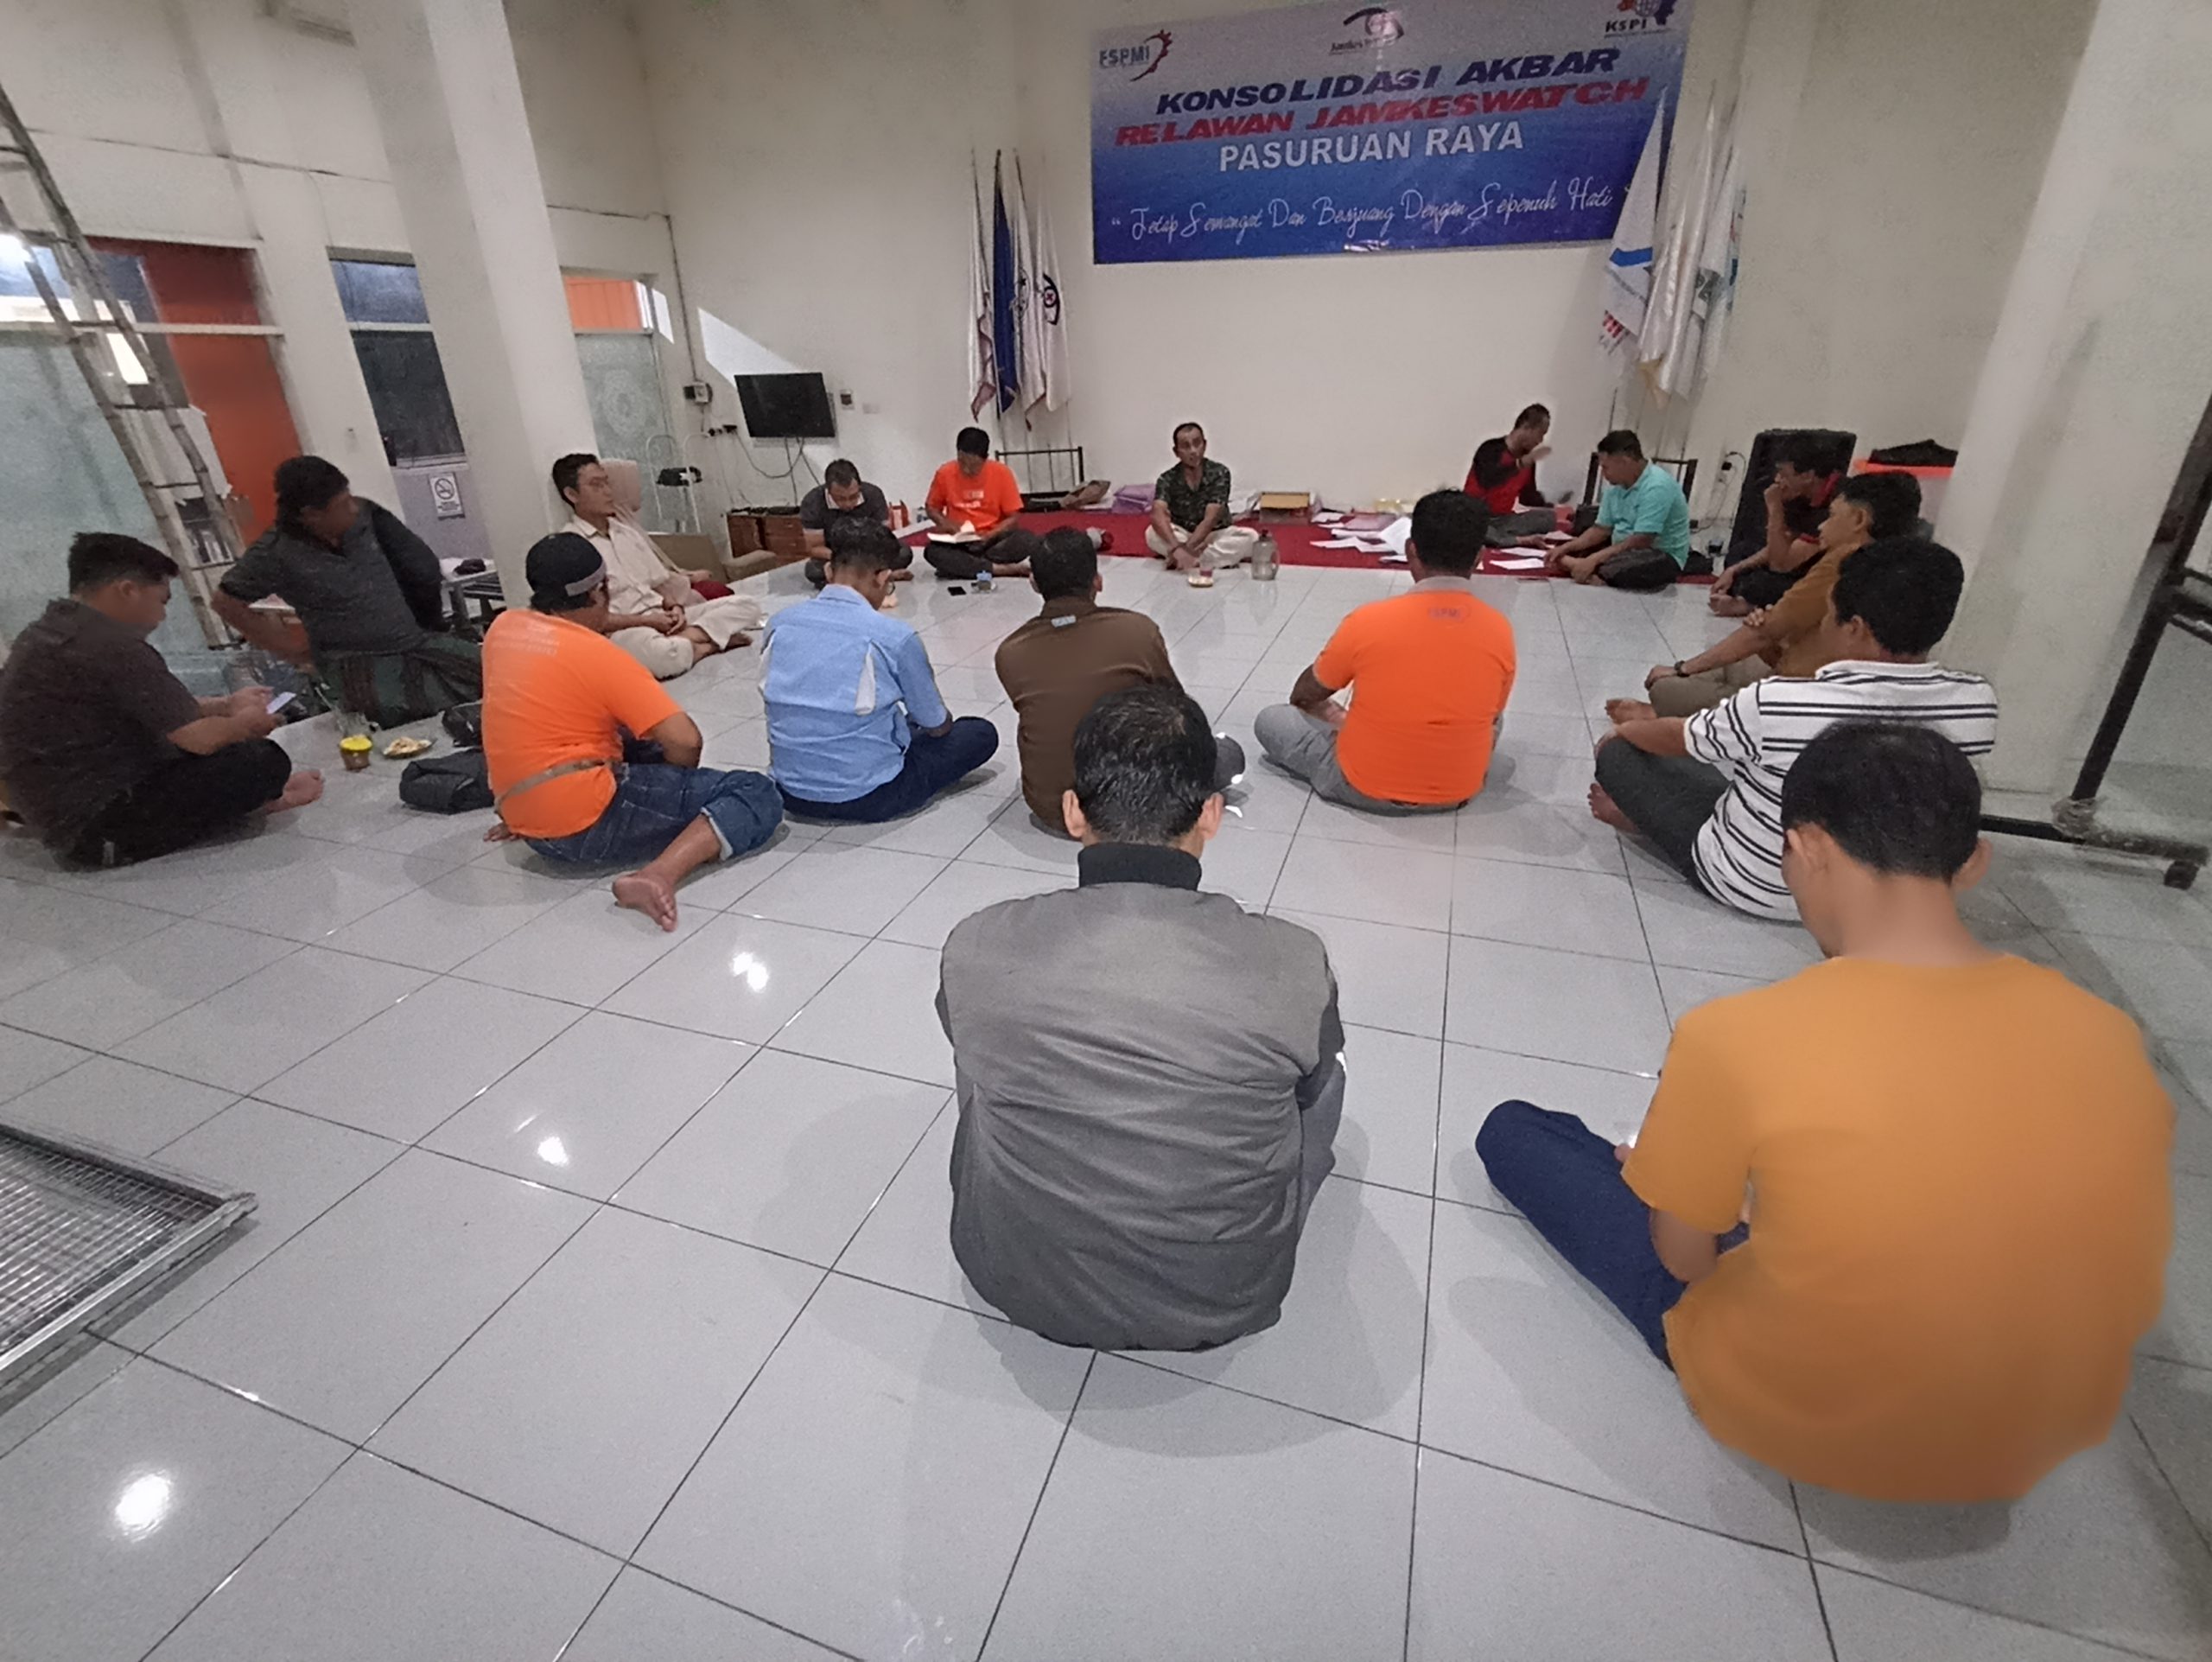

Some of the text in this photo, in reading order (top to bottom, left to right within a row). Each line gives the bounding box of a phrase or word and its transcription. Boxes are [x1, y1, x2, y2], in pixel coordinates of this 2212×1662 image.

[1605, 18, 1647, 33] KSPI
[1099, 46, 1150, 65] FSPMI
[1156, 48, 1621, 115] KONSOLIDASI AKBAR
[1115, 76, 1649, 147] RELAWAN JAMKESWATCH
[1219, 121, 1523, 172] PASURUAN RAYA
[1268, 198, 1306, 227] Dan
[1400, 188, 1466, 234] Dengan
[1466, 181, 1558, 226] Sepenuh
[1567, 176, 1613, 211] Hati
